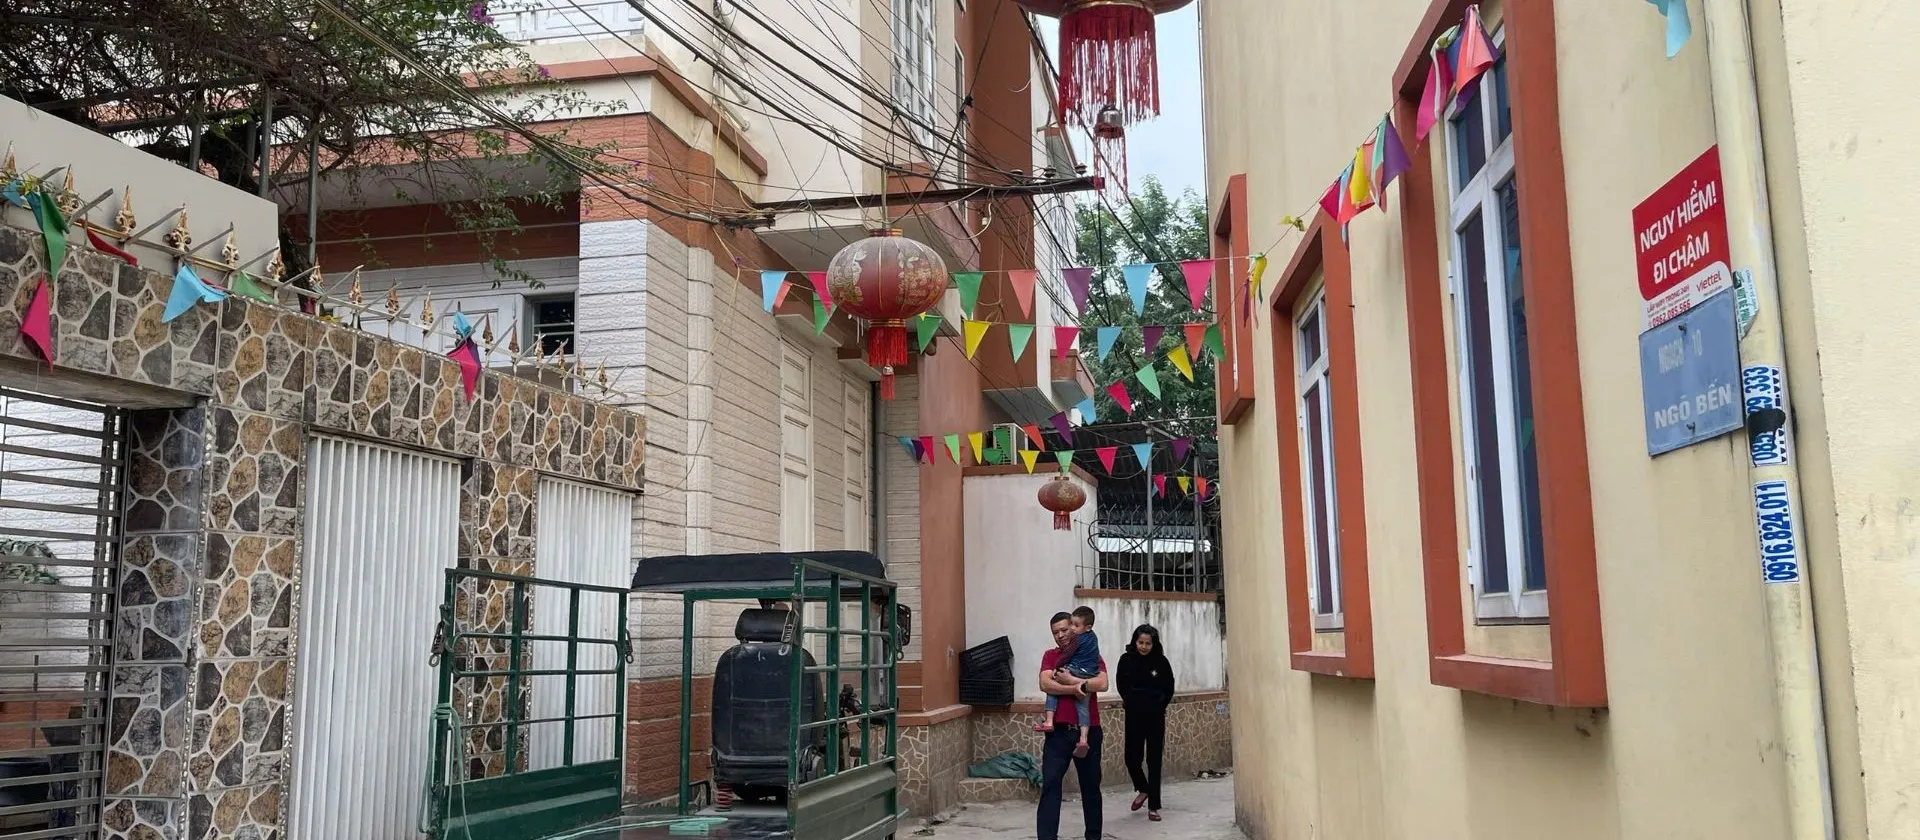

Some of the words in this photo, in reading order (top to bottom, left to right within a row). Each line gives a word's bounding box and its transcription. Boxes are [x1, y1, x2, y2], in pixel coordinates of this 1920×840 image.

[1640, 209, 1675, 253] NGUY
[1676, 180, 1717, 228] HIỂM!
[1653, 258, 1667, 284] ĐI
[1668, 231, 1710, 275] CHẬM
[1696, 271, 1722, 292] viettel
[1654, 394, 1690, 429] NGÕ
[1695, 378, 1732, 415] BẾN
[1757, 483, 1799, 582] 0916.824.011
